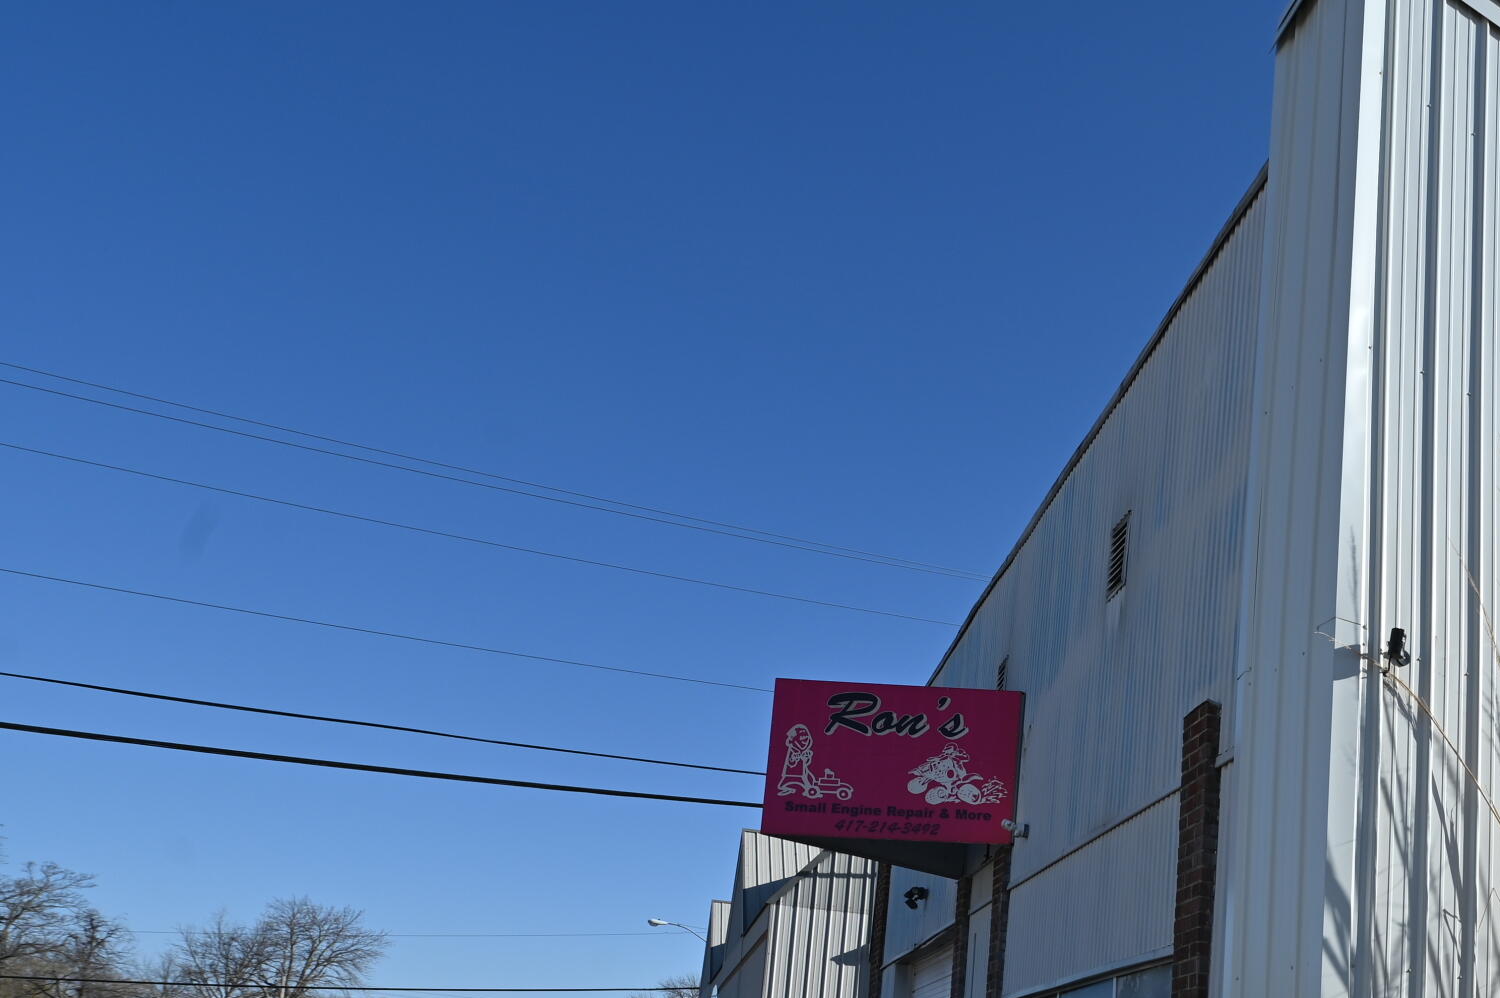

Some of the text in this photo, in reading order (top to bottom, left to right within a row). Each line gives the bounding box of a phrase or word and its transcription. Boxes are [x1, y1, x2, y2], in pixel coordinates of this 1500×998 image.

[824, 692, 969, 740] Ron's
[785, 801, 992, 822] Small Engine Repair & More
